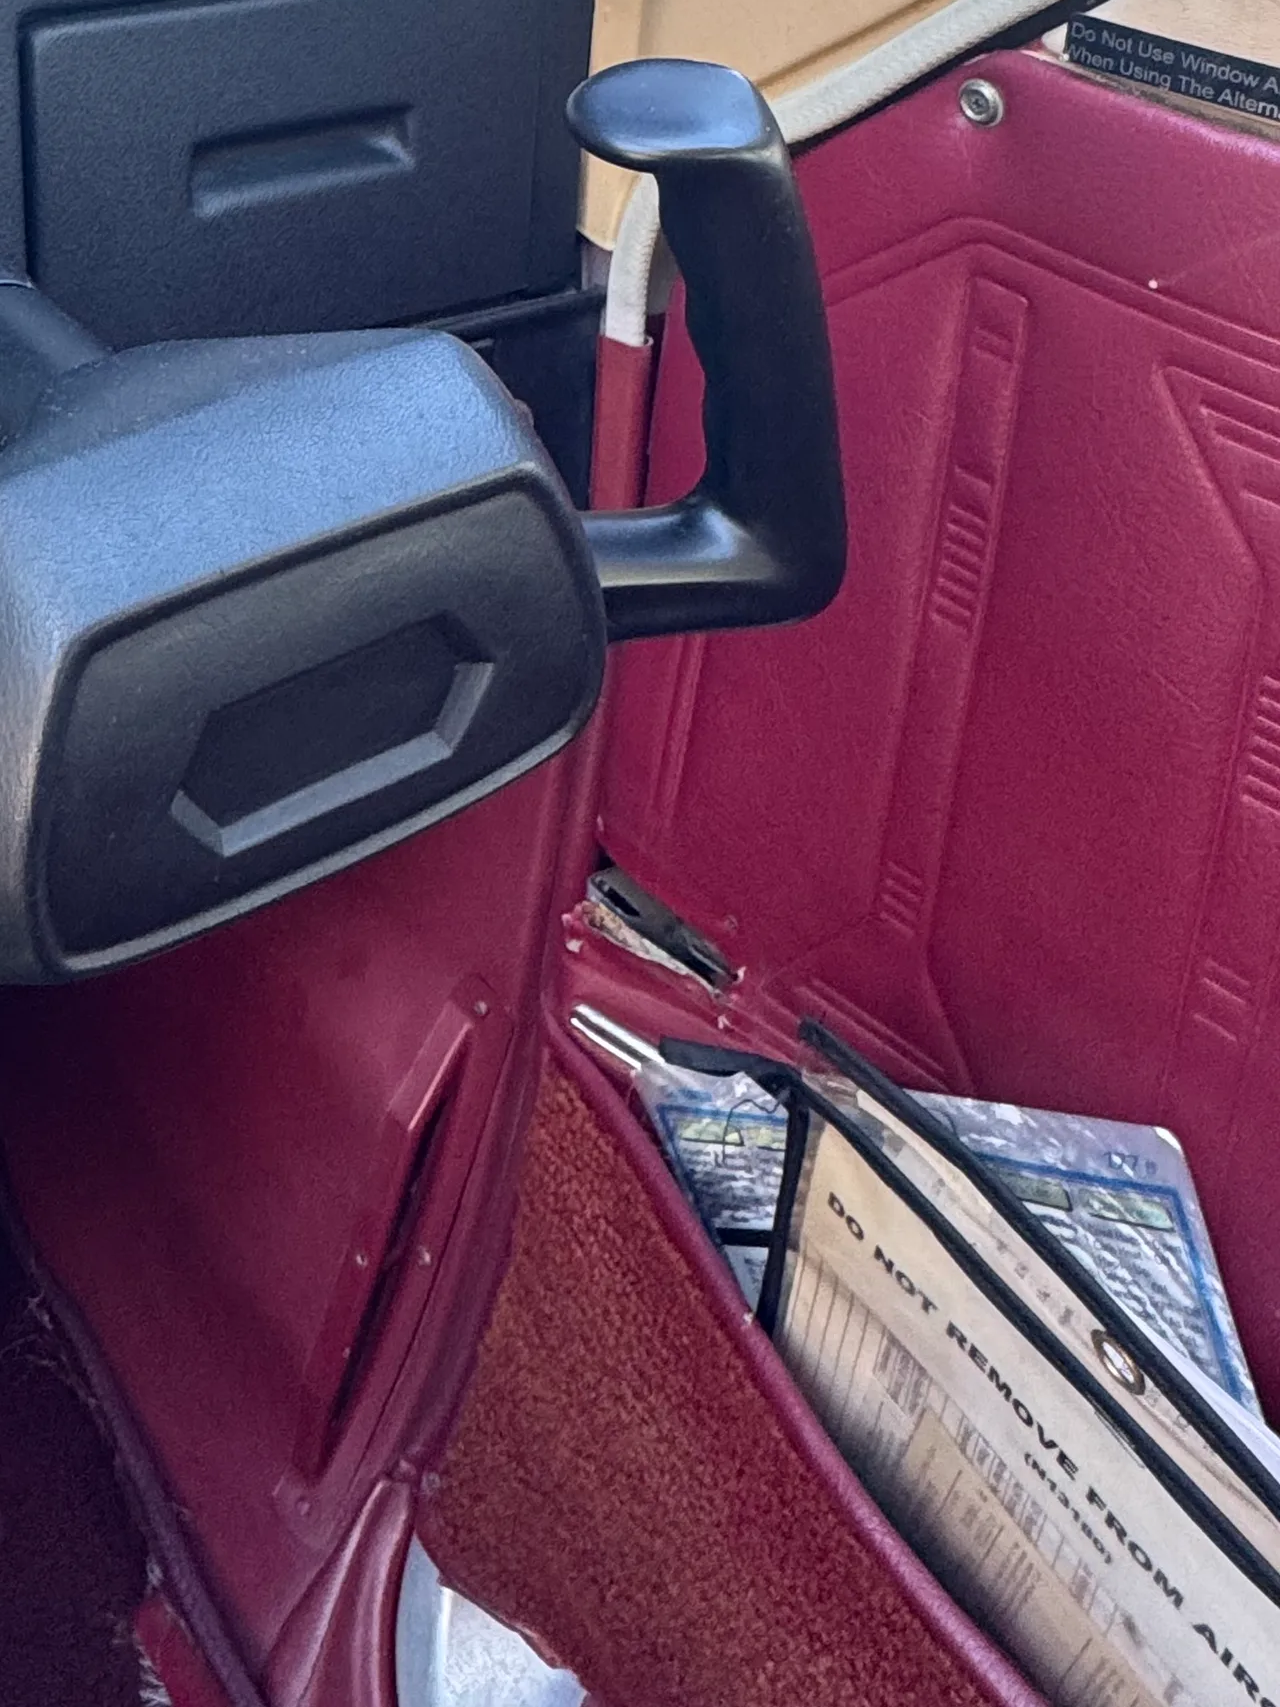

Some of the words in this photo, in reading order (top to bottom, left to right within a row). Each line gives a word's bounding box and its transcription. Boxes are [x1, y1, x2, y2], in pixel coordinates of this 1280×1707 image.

[1071, 21, 1096, 43] Do
[1101, 29, 1133, 54] Not
[1138, 40, 1176, 65] Use
[1180, 51, 1261, 89] Window
[1120, 57, 1172, 89] Using
[1178, 74, 1216, 100] The
[1217, 87, 1280, 119] Altern
[827, 1191, 865, 1242] DO
[873, 1244, 939, 1316] NOT
[945, 1320, 1079, 1482] REMOVE
[1085, 1485, 1184, 1611] FROM
